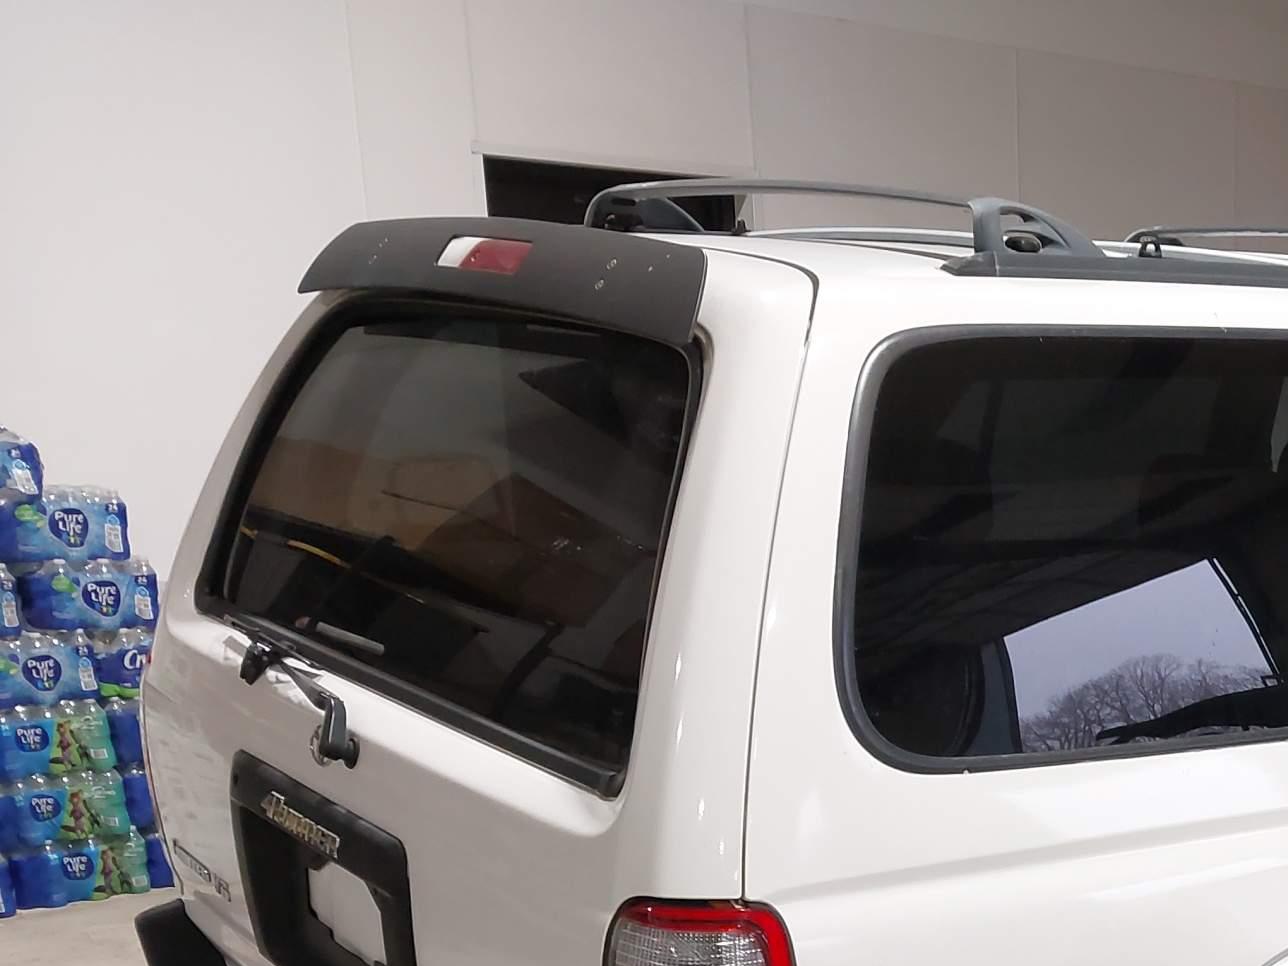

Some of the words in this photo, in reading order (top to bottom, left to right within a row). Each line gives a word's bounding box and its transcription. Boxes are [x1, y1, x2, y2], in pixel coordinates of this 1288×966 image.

[54, 510, 84, 523] Pure
[58, 521, 82, 535] Life
[87, 583, 117, 595] Pure
[91, 592, 115, 606] Life
[27, 658, 55, 671] Pure
[32, 668, 55, 681] Life
[16, 728, 43, 737] Pure
[21, 734, 41, 745] Life
[31, 797, 54, 807] Pure
[35, 804, 53, 816] Life
[63, 855, 88, 865] Pure
[67, 862, 86, 876] Life
